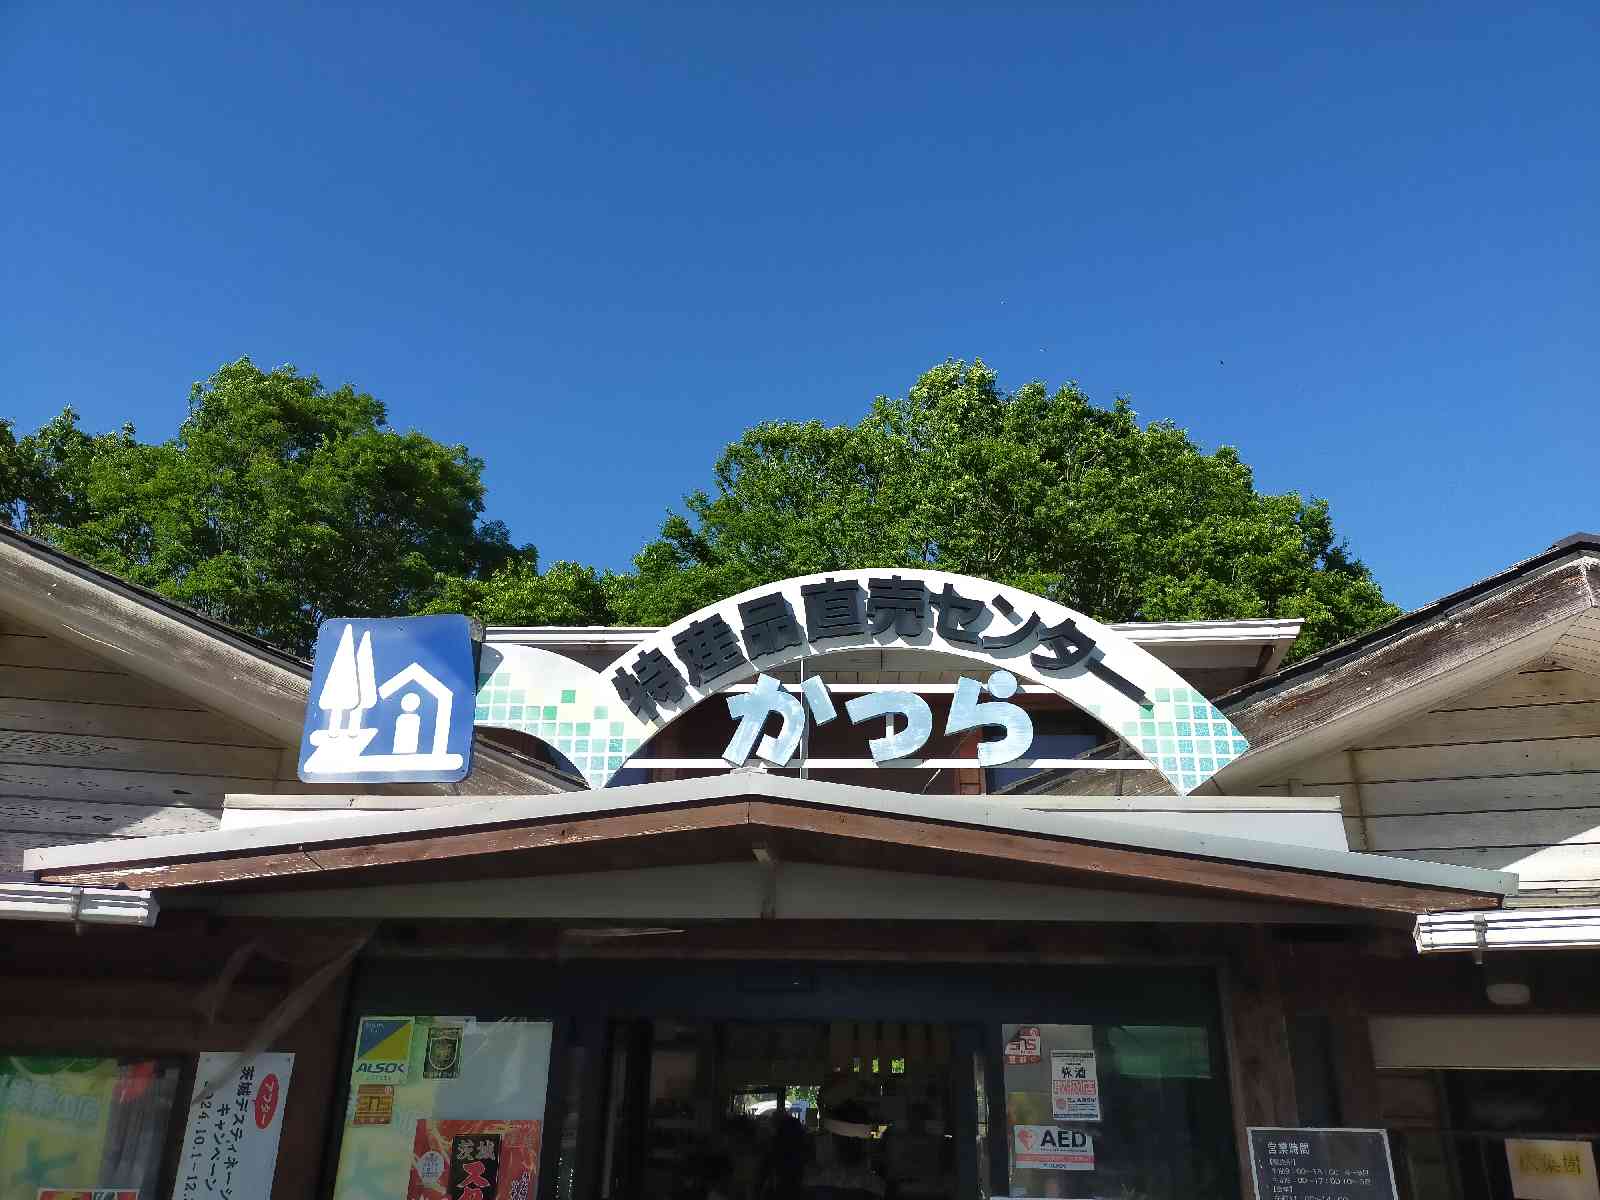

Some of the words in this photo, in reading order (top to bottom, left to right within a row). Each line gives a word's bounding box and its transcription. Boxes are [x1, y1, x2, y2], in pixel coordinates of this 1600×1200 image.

[611, 574, 1150, 722] 特産品直売センター
[722, 670, 1034, 768] かつら
[355, 1062, 405, 1073] ALSOK
[203, 1103, 230, 1193] キャンペーン
[1040, 1129, 1087, 1148] AED
[1267, 1142, 1310, 1155] 営業時間
